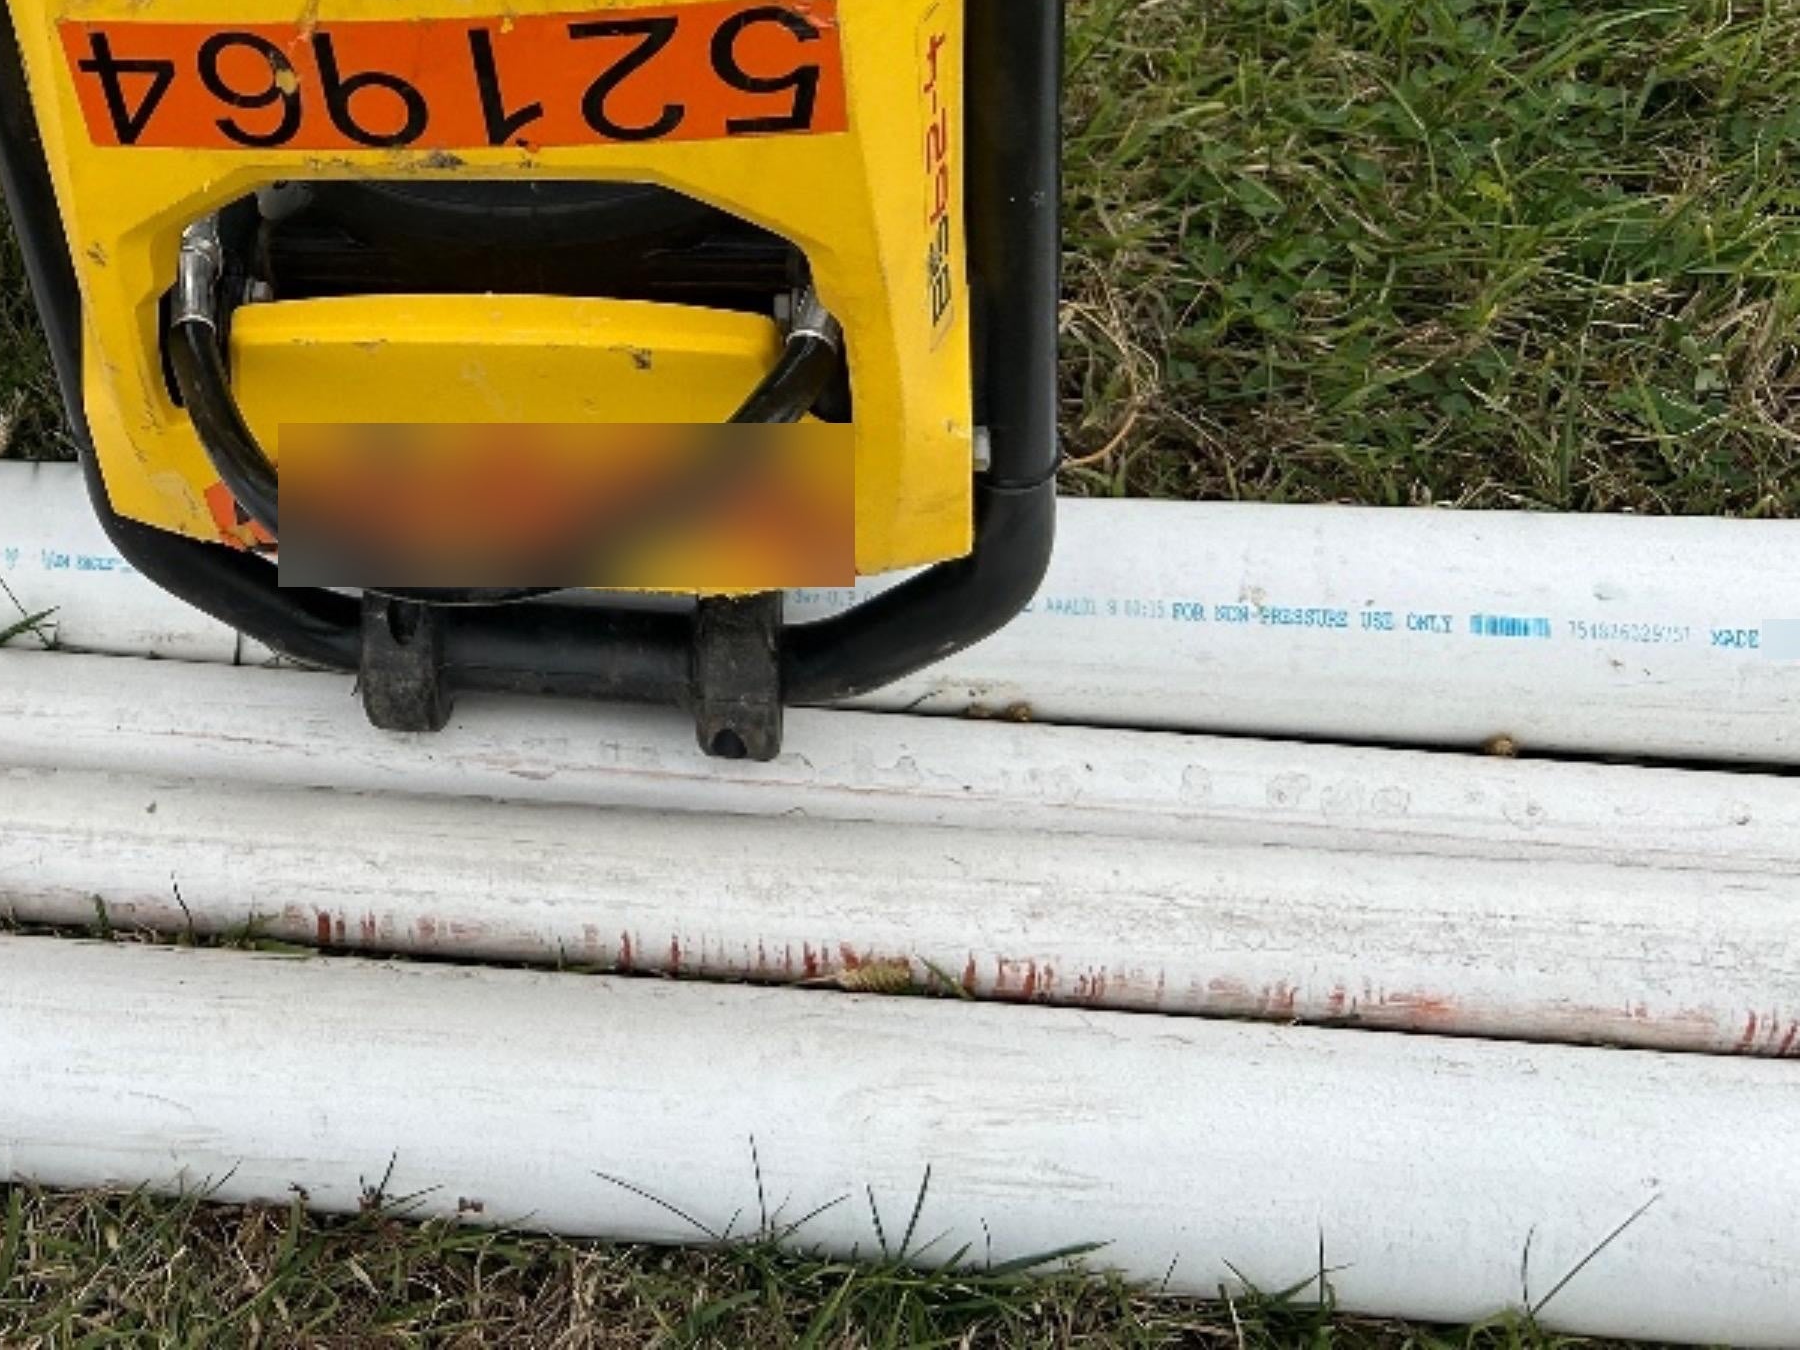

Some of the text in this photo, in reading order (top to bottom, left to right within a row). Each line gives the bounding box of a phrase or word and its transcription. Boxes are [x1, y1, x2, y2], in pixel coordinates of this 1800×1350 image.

[79, 5, 820, 147] 521964
[1172, 602, 1207, 624] FOR
[1213, 604, 1349, 629] NON-PRESSURE
[1360, 610, 1395, 631] USE
[1406, 612, 1454, 634] ONLY
[1710, 628, 1760, 650] MADE
